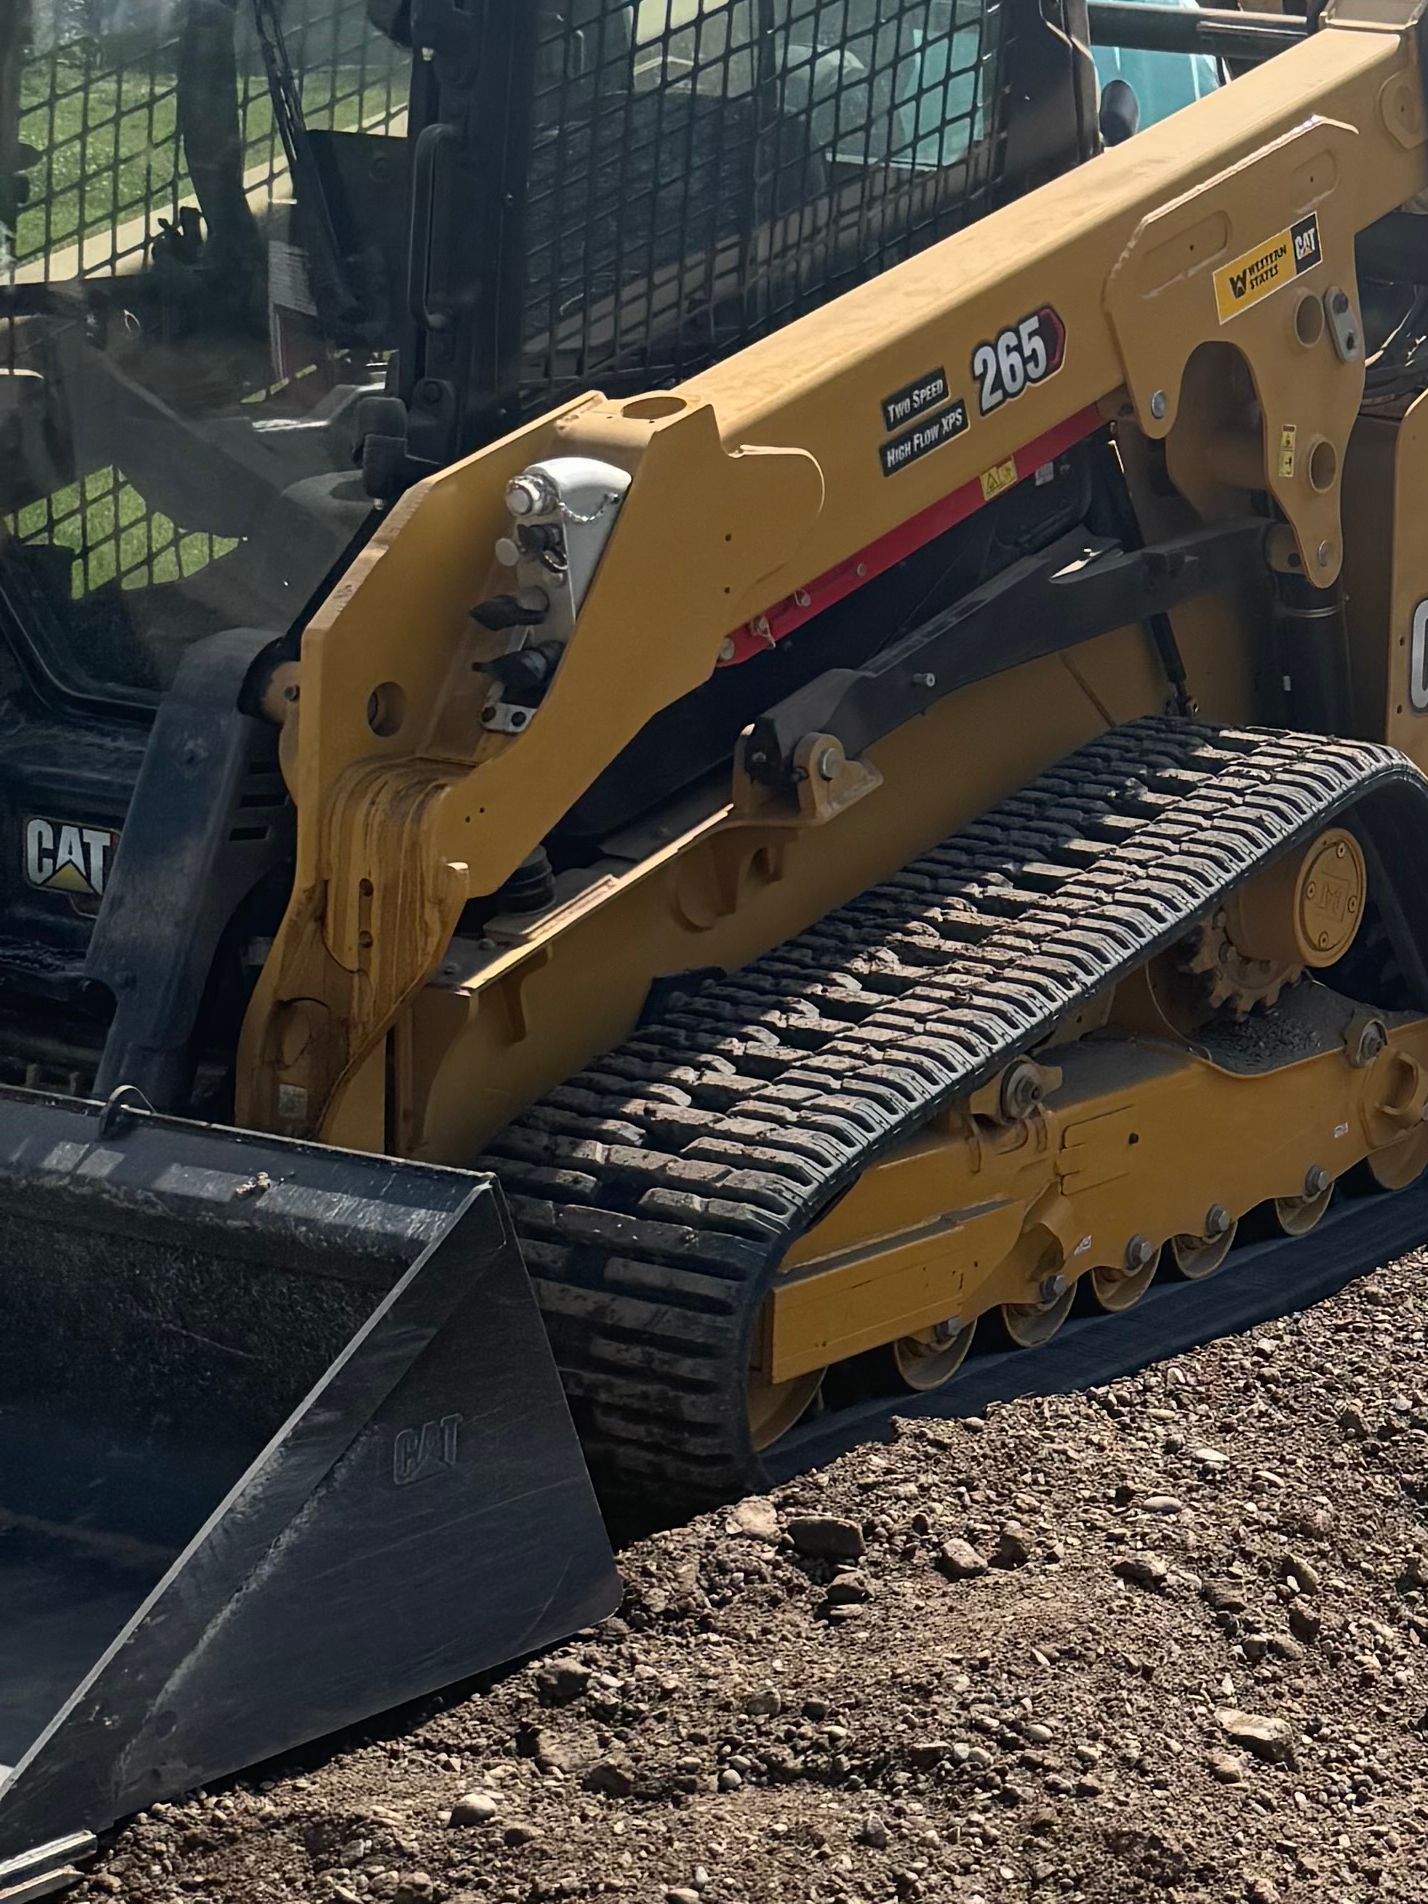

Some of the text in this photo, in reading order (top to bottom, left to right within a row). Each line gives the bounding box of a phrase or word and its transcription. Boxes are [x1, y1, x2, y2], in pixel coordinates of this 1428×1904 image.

[1246, 244, 1287, 276] WESTERN
[1294, 227, 1316, 260] CAT
[1249, 264, 1279, 290] STATES
[973, 315, 1047, 411] 265
[941, 408, 963, 435] XPS
[27, 819, 111, 896] CAT
[393, 1413, 463, 1485] CAT
